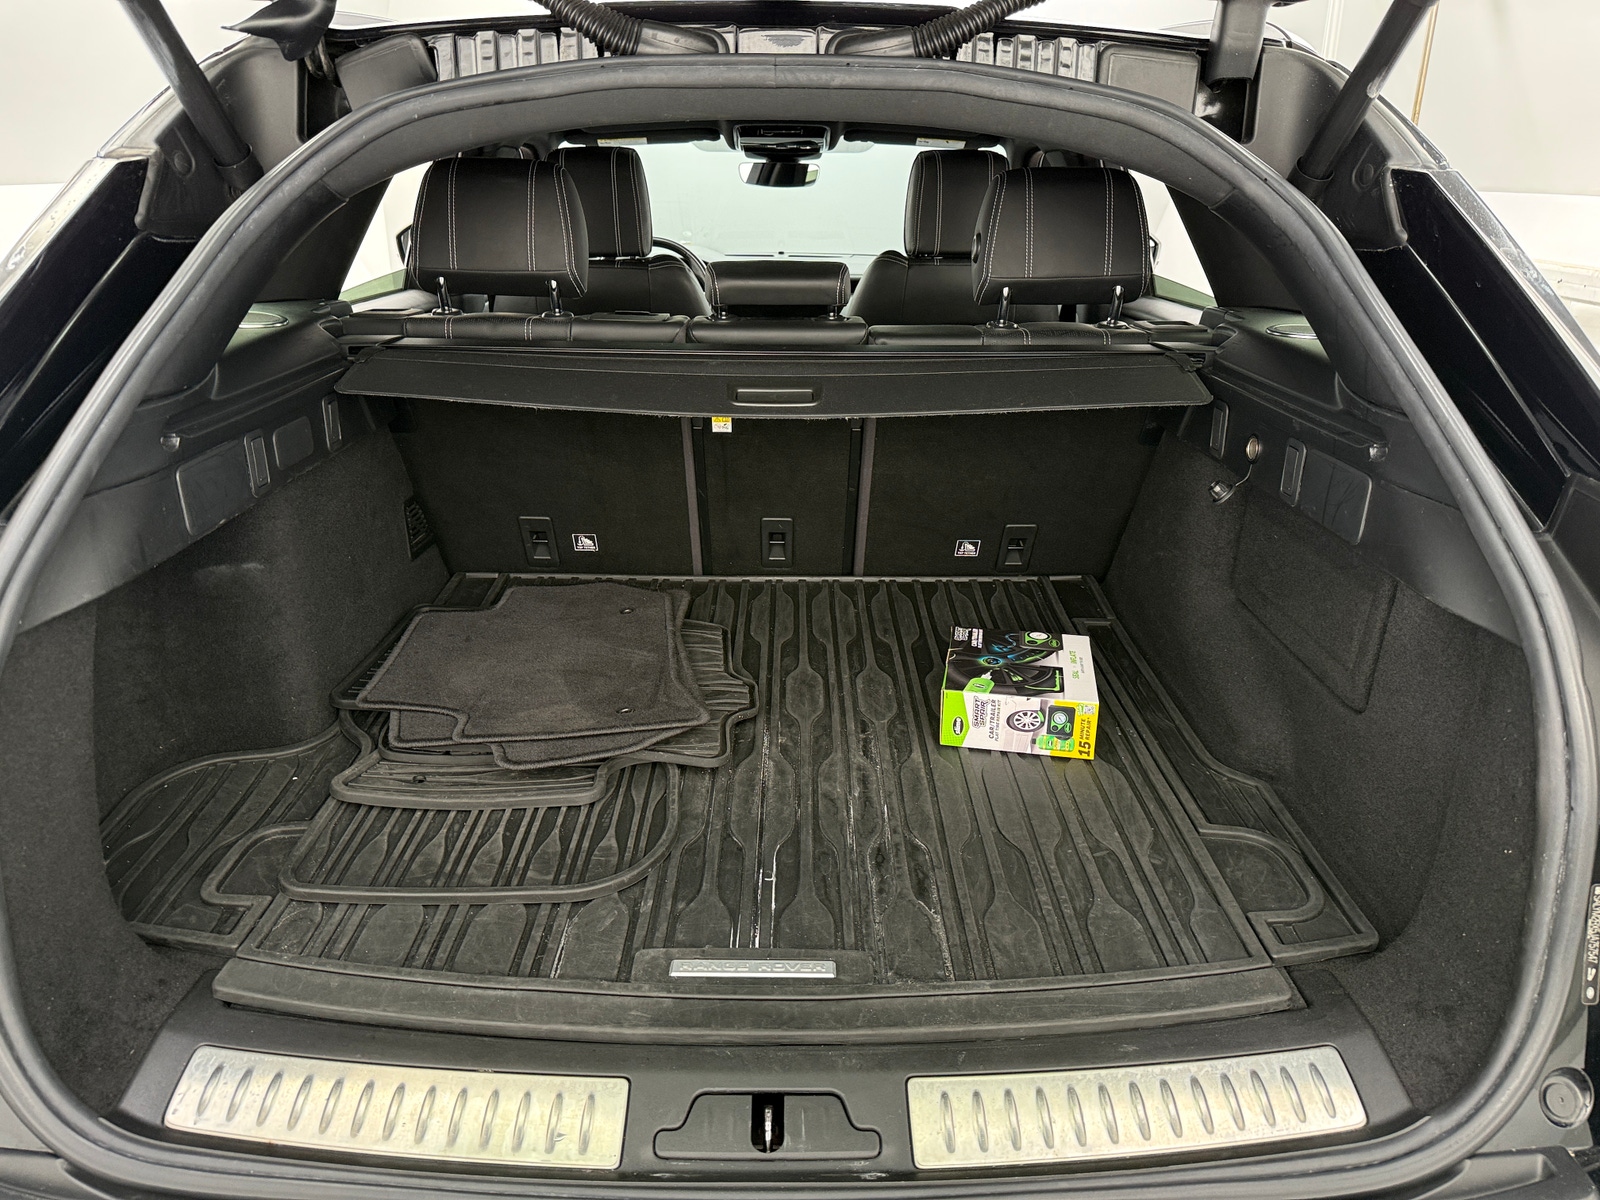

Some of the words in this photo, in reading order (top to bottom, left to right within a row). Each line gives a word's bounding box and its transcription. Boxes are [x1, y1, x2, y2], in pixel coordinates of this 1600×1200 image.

[973, 698, 981, 727] SMART
[979, 699, 988, 726] SPAIR
[988, 699, 997, 739] CAR/TRAILER
[1078, 741, 1091, 757] 15
[679, 962, 750, 972] RANGE
[758, 962, 827, 973] ROVER
